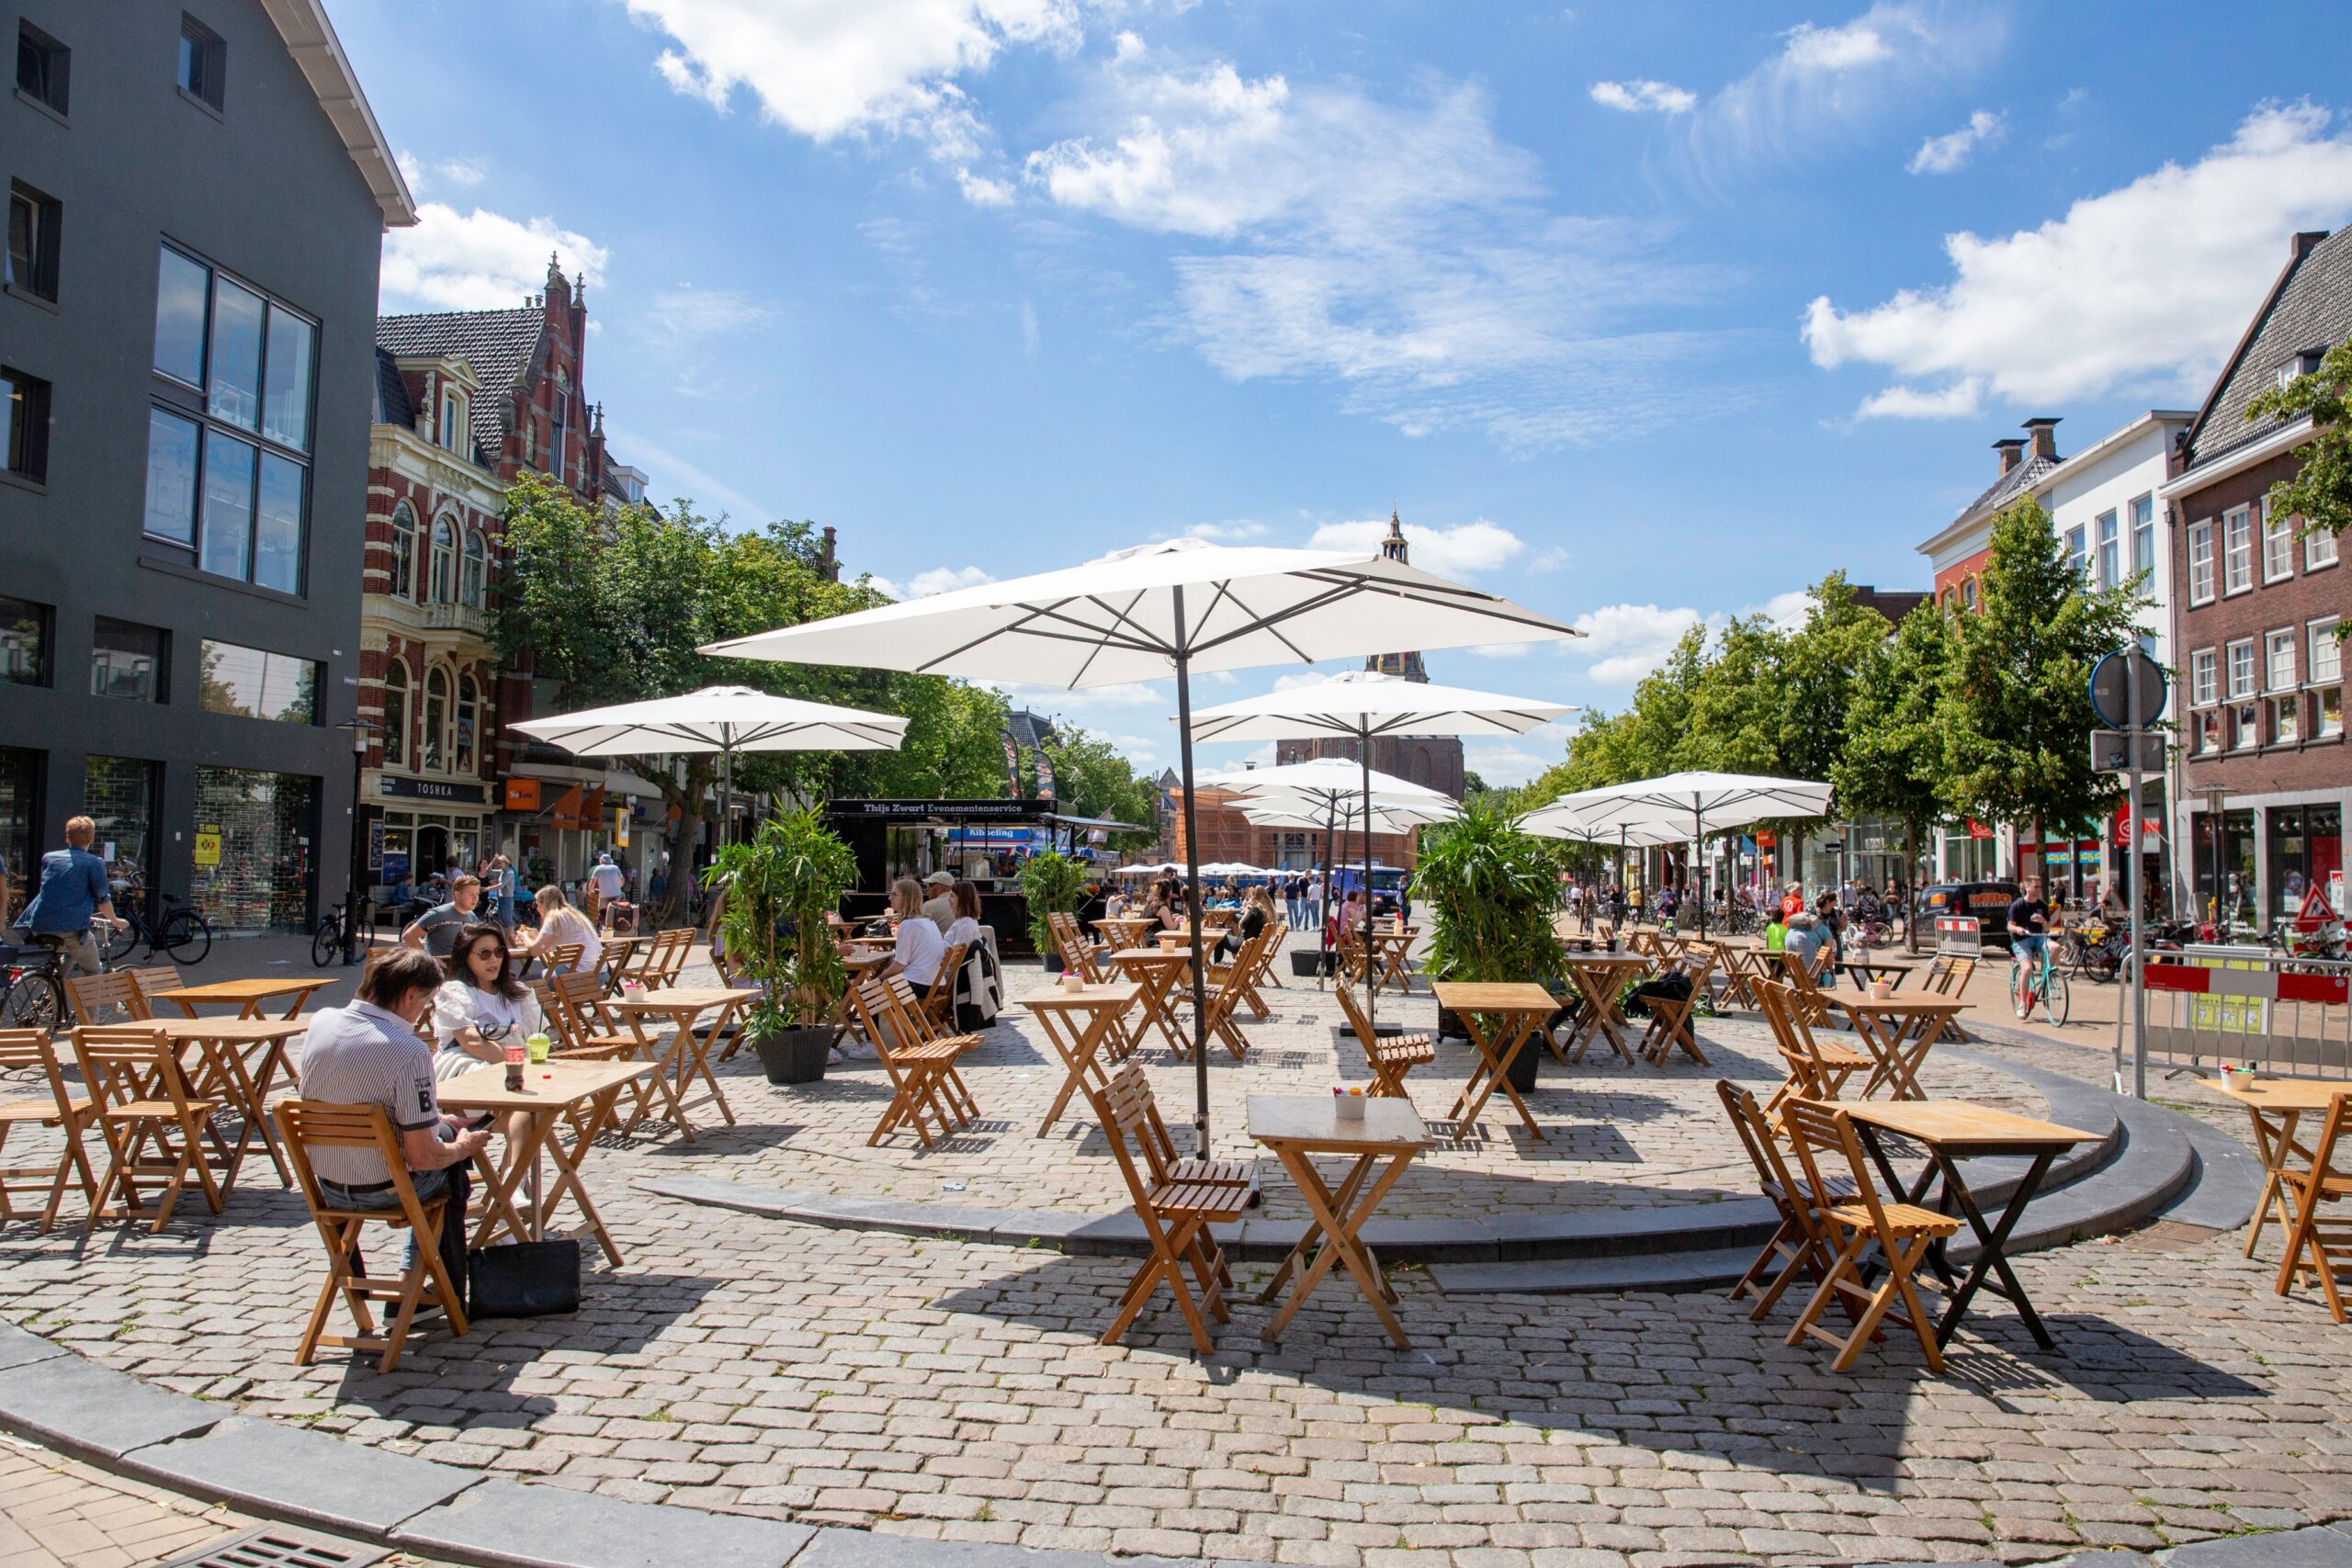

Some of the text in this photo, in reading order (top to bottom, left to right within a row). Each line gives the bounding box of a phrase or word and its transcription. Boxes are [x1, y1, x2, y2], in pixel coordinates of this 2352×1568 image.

[417, 784, 452, 795] TOSHKA
[864, 804, 1023, 813] Thijs Zwart Evenementenservice
[419, 1090, 433, 1112] B
